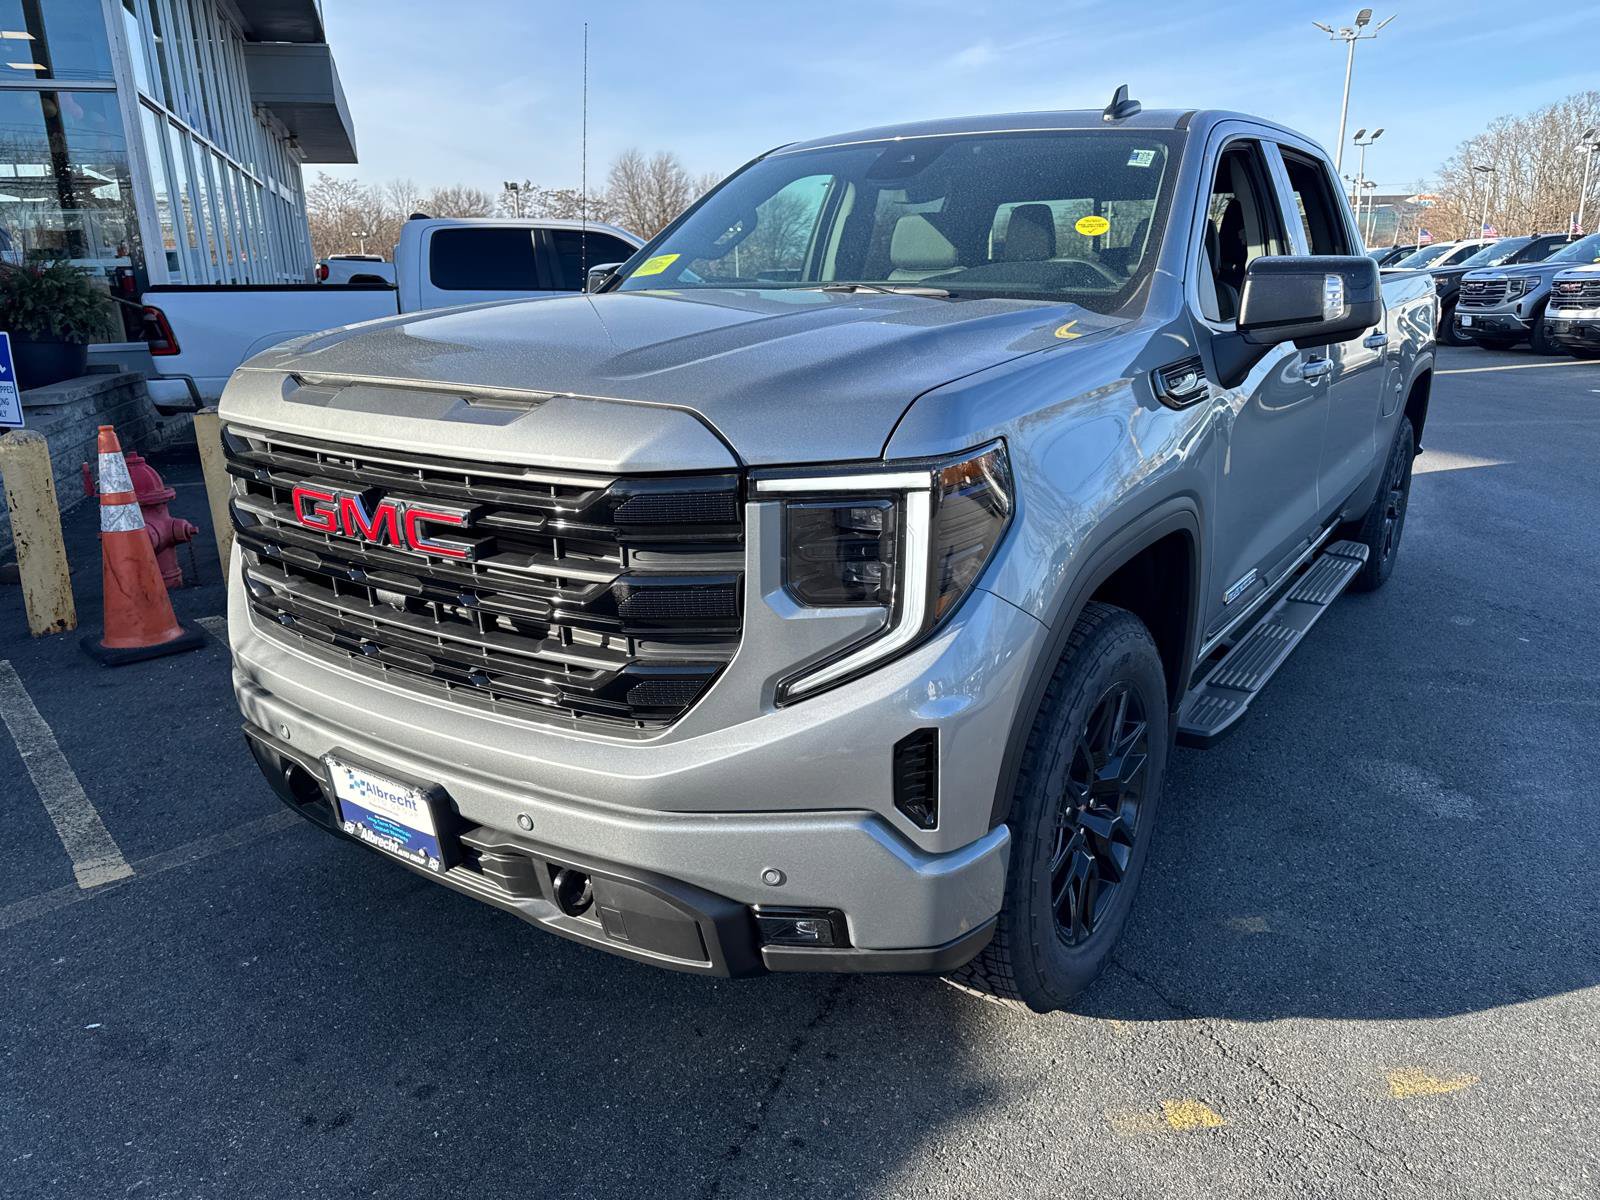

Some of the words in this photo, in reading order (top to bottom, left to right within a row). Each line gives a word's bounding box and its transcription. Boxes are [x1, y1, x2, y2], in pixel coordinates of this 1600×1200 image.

[292, 482, 474, 560] GMC
[366, 781, 418, 811] Albrecht
[360, 827, 399, 855] Albrecht
